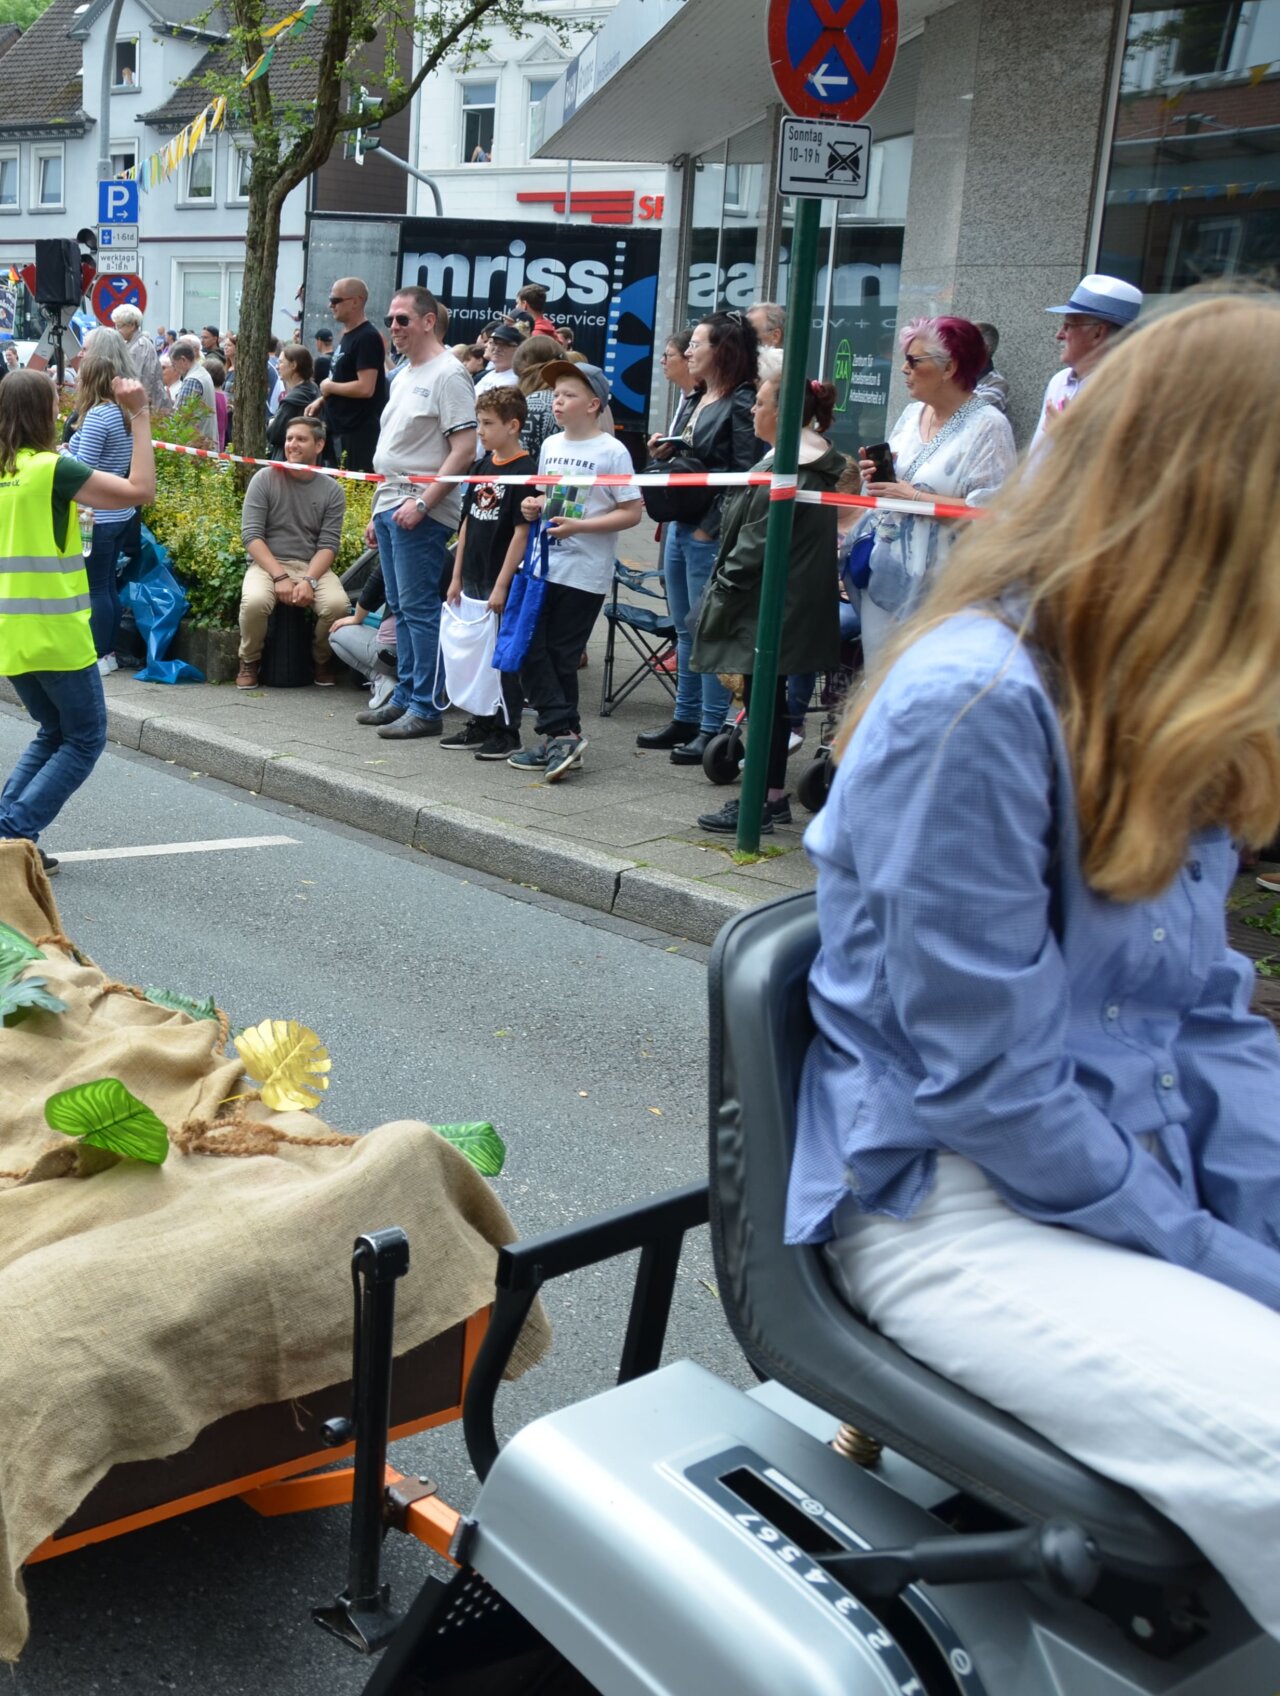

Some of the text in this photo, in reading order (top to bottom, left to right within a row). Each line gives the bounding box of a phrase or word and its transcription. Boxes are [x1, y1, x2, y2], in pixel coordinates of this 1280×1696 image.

[789, 126, 822, 146] Sonntag
[789, 146, 820, 163] 10-19 h
[107, 185, 130, 218] P
[100, 253, 135, 263] werktags
[401, 239, 609, 305] mriss
[835, 360, 849, 379] ZAA
